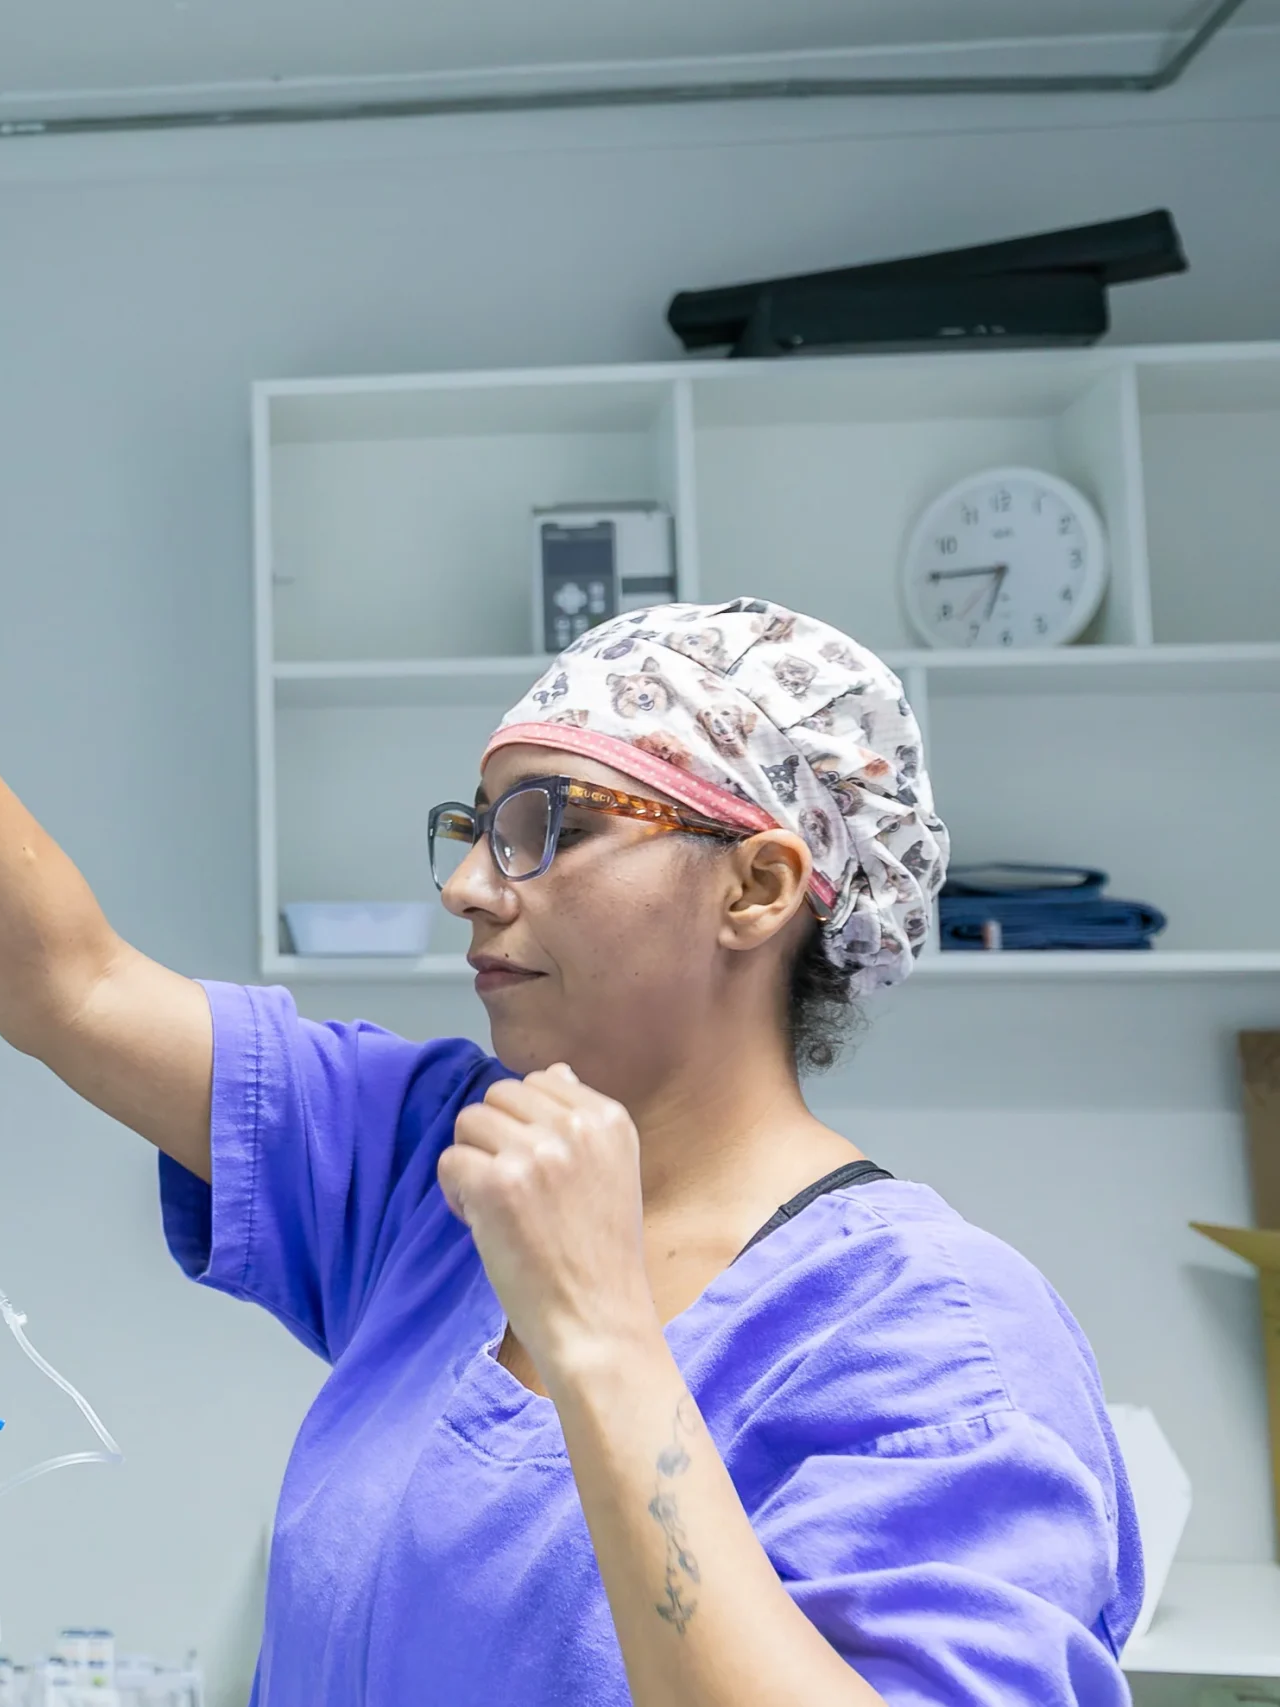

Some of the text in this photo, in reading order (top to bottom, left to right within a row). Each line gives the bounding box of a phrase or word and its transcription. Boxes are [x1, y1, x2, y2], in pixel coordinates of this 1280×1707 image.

[988, 489, 1012, 513] 12
[961, 503, 979, 526] 11
[1058, 513, 1076, 535] 2
[934, 535, 958, 555] 10
[1068, 549, 1082, 571] 3
[1060, 585, 1073, 605] 4
[1033, 612, 1048, 635] 5
[1000, 628, 1013, 648] 6
